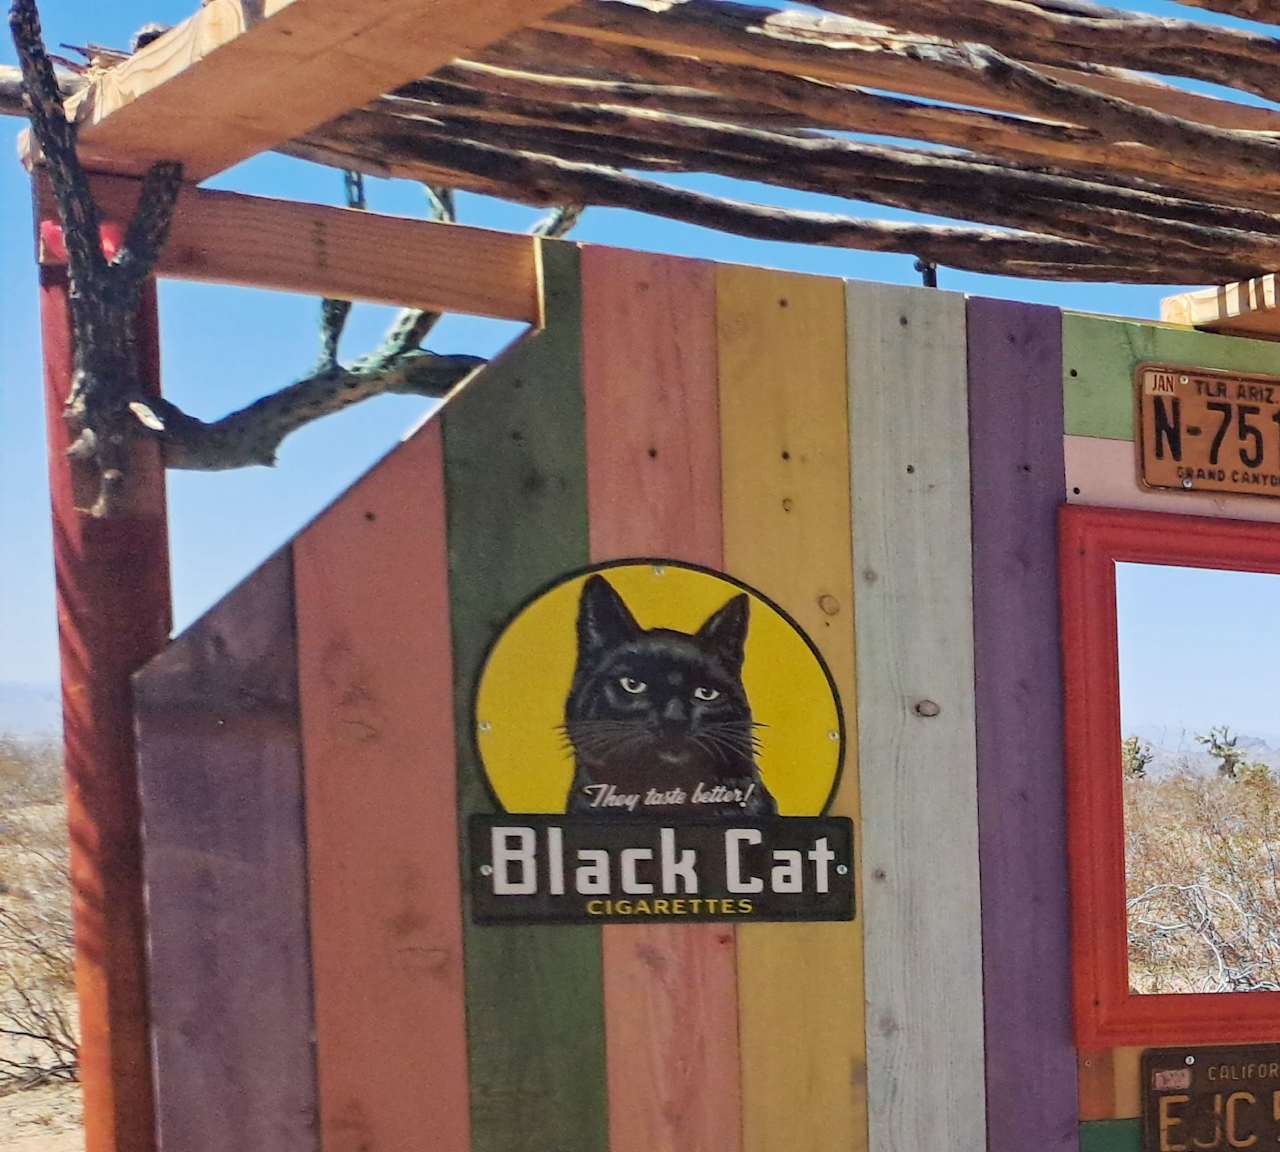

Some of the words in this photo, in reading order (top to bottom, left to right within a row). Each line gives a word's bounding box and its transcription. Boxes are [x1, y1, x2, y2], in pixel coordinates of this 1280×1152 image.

[1152, 374, 1174, 393] JAN
[1193, 379, 1227, 398] TLR
[1176, 466, 1226, 483] GRAND
[583, 783, 641, 812] They
[643, 787, 688, 806] taste
[690, 781, 756, 808] better!
[491, 826, 699, 896] Black
[724, 827, 836, 894] Cat
[586, 899, 754, 916] CIGARETTES
[1159, 1090, 1257, 1152] EJC
